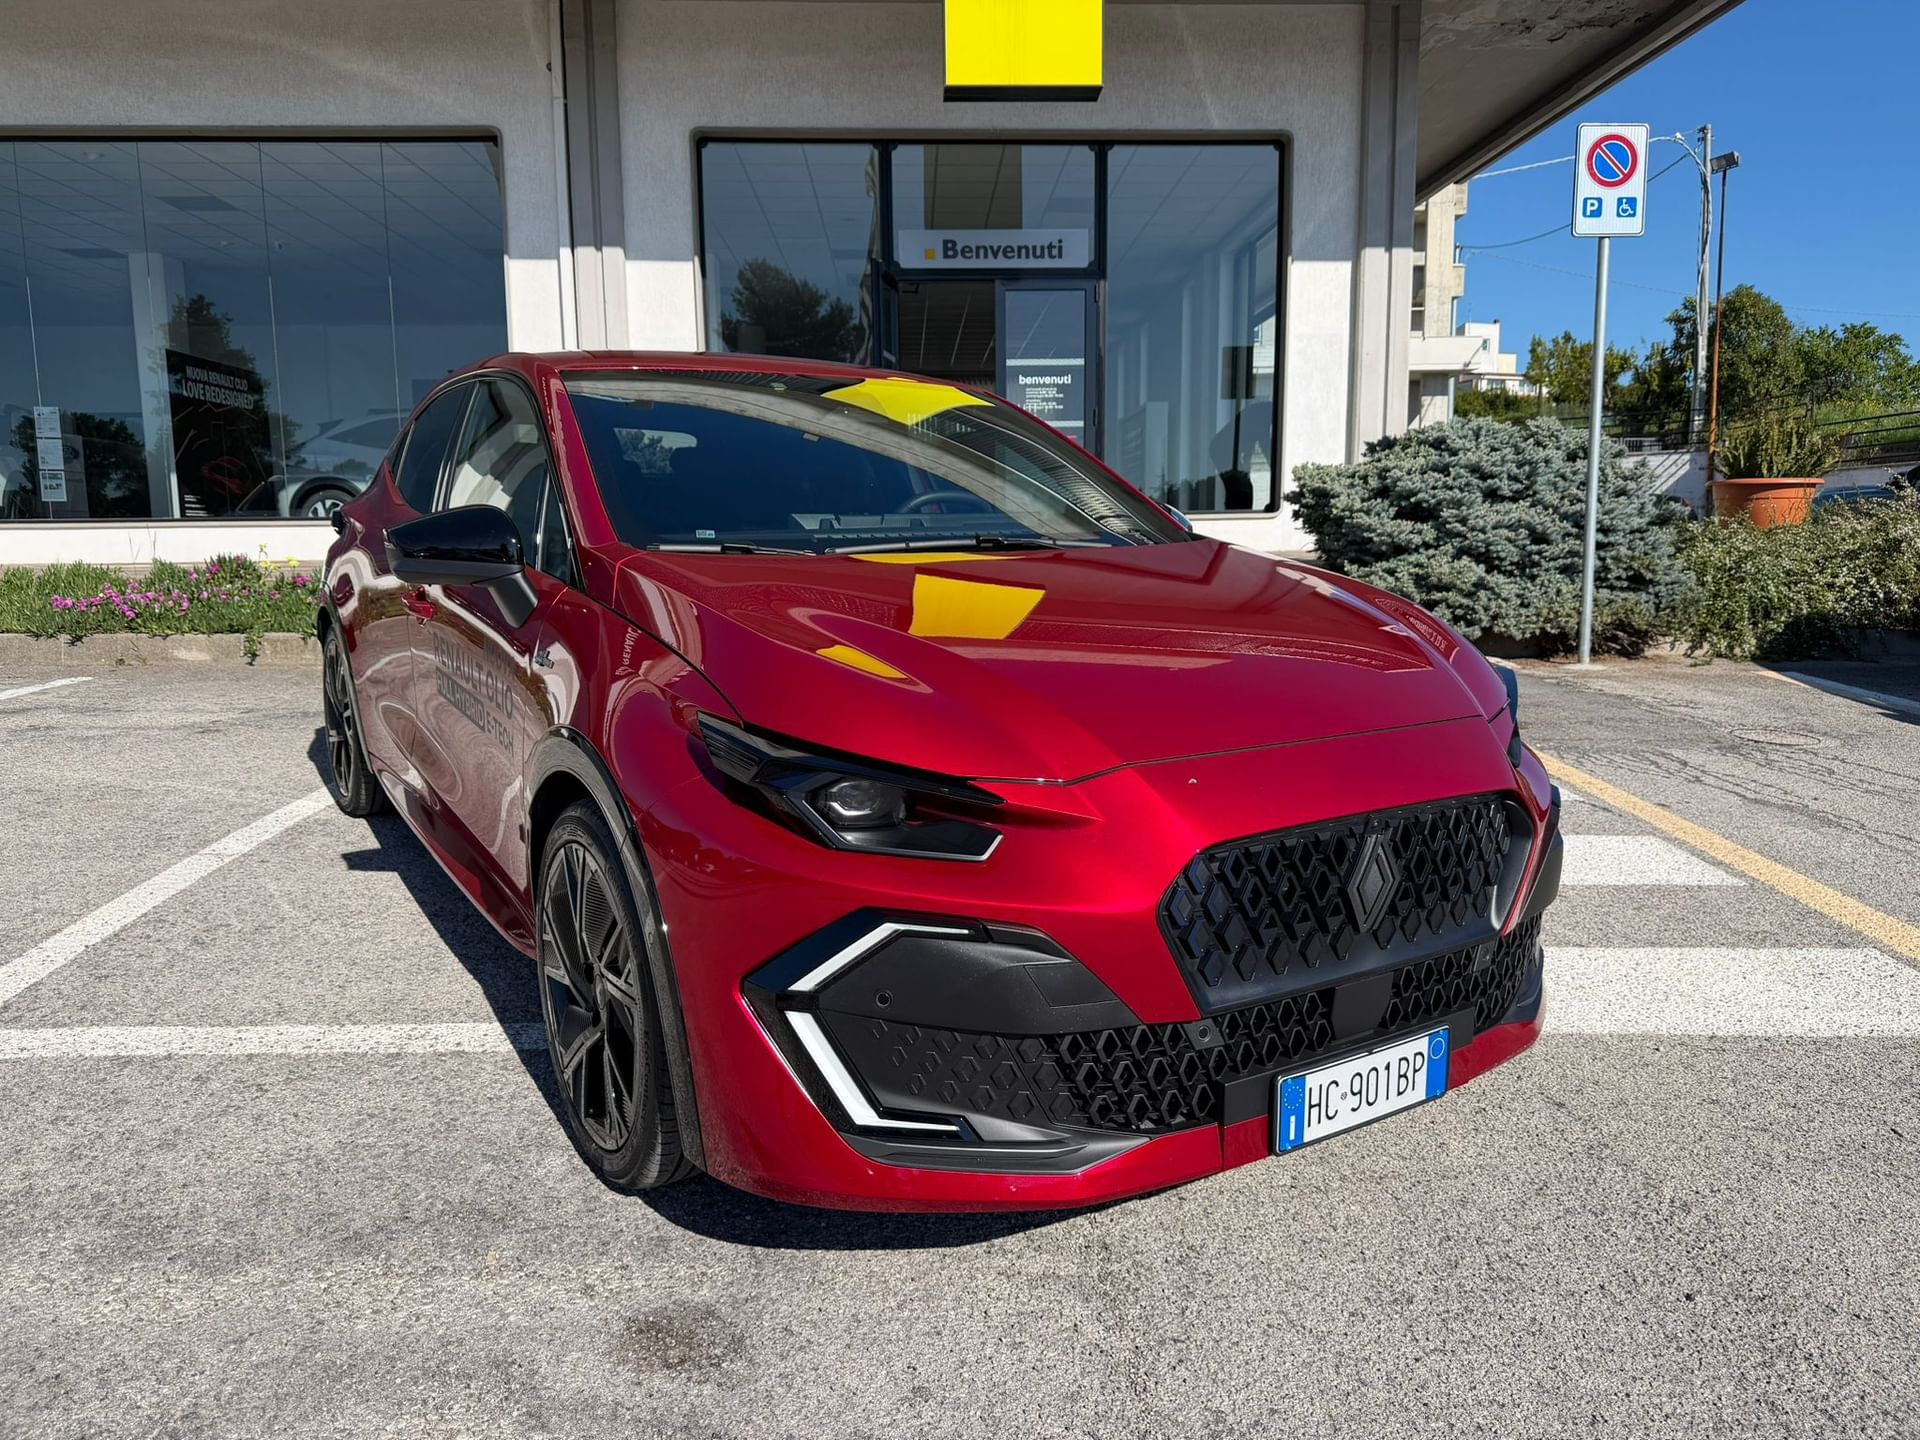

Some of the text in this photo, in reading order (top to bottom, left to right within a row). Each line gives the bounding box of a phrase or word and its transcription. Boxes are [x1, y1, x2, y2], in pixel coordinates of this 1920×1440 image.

[1586, 200, 1598, 216] P
[942, 239, 1063, 260] Benvenuti
[208, 371, 235, 388] RENAULT
[1018, 374, 1071, 384] benvenuti
[183, 379, 254, 409] LOVE REDESIGNED
[433, 631, 513, 720] RENAULT CLIO
[486, 710, 514, 758] E-TECH
[1308, 1051, 1425, 1128] HC 901BP
